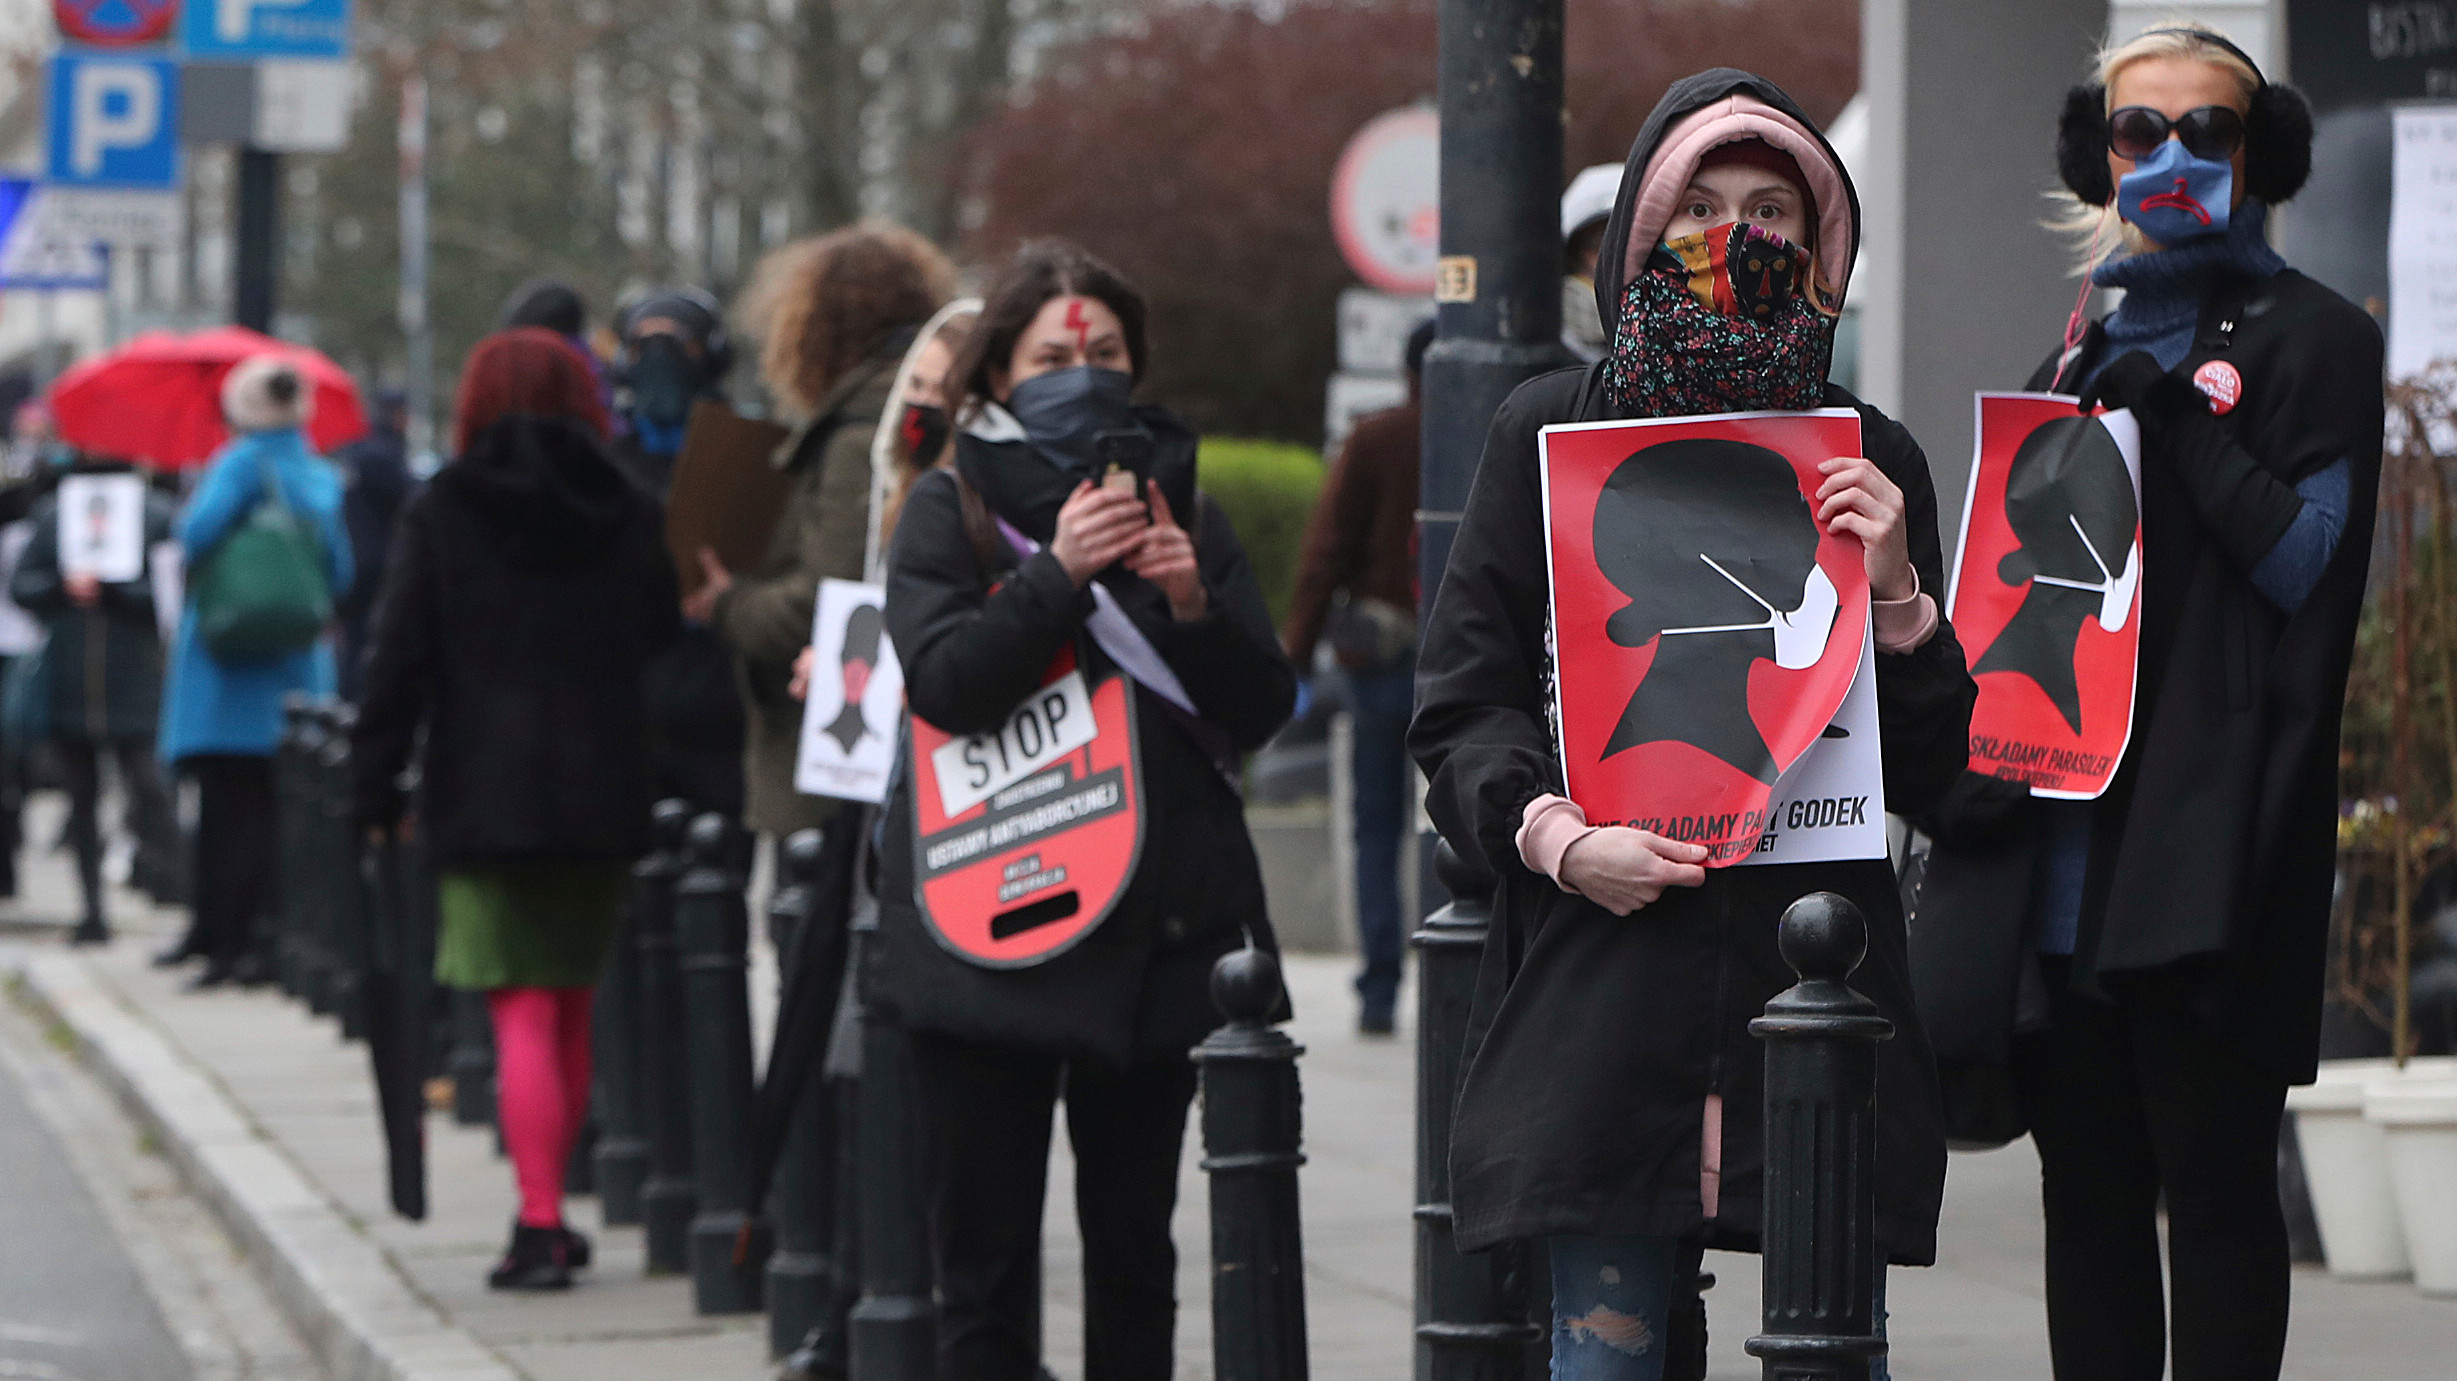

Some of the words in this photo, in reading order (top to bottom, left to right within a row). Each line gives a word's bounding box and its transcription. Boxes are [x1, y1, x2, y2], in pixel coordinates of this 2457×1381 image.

[71, 63, 162, 178] P
[963, 692, 1067, 789] STOP
[1787, 796, 1868, 830] GODEK
